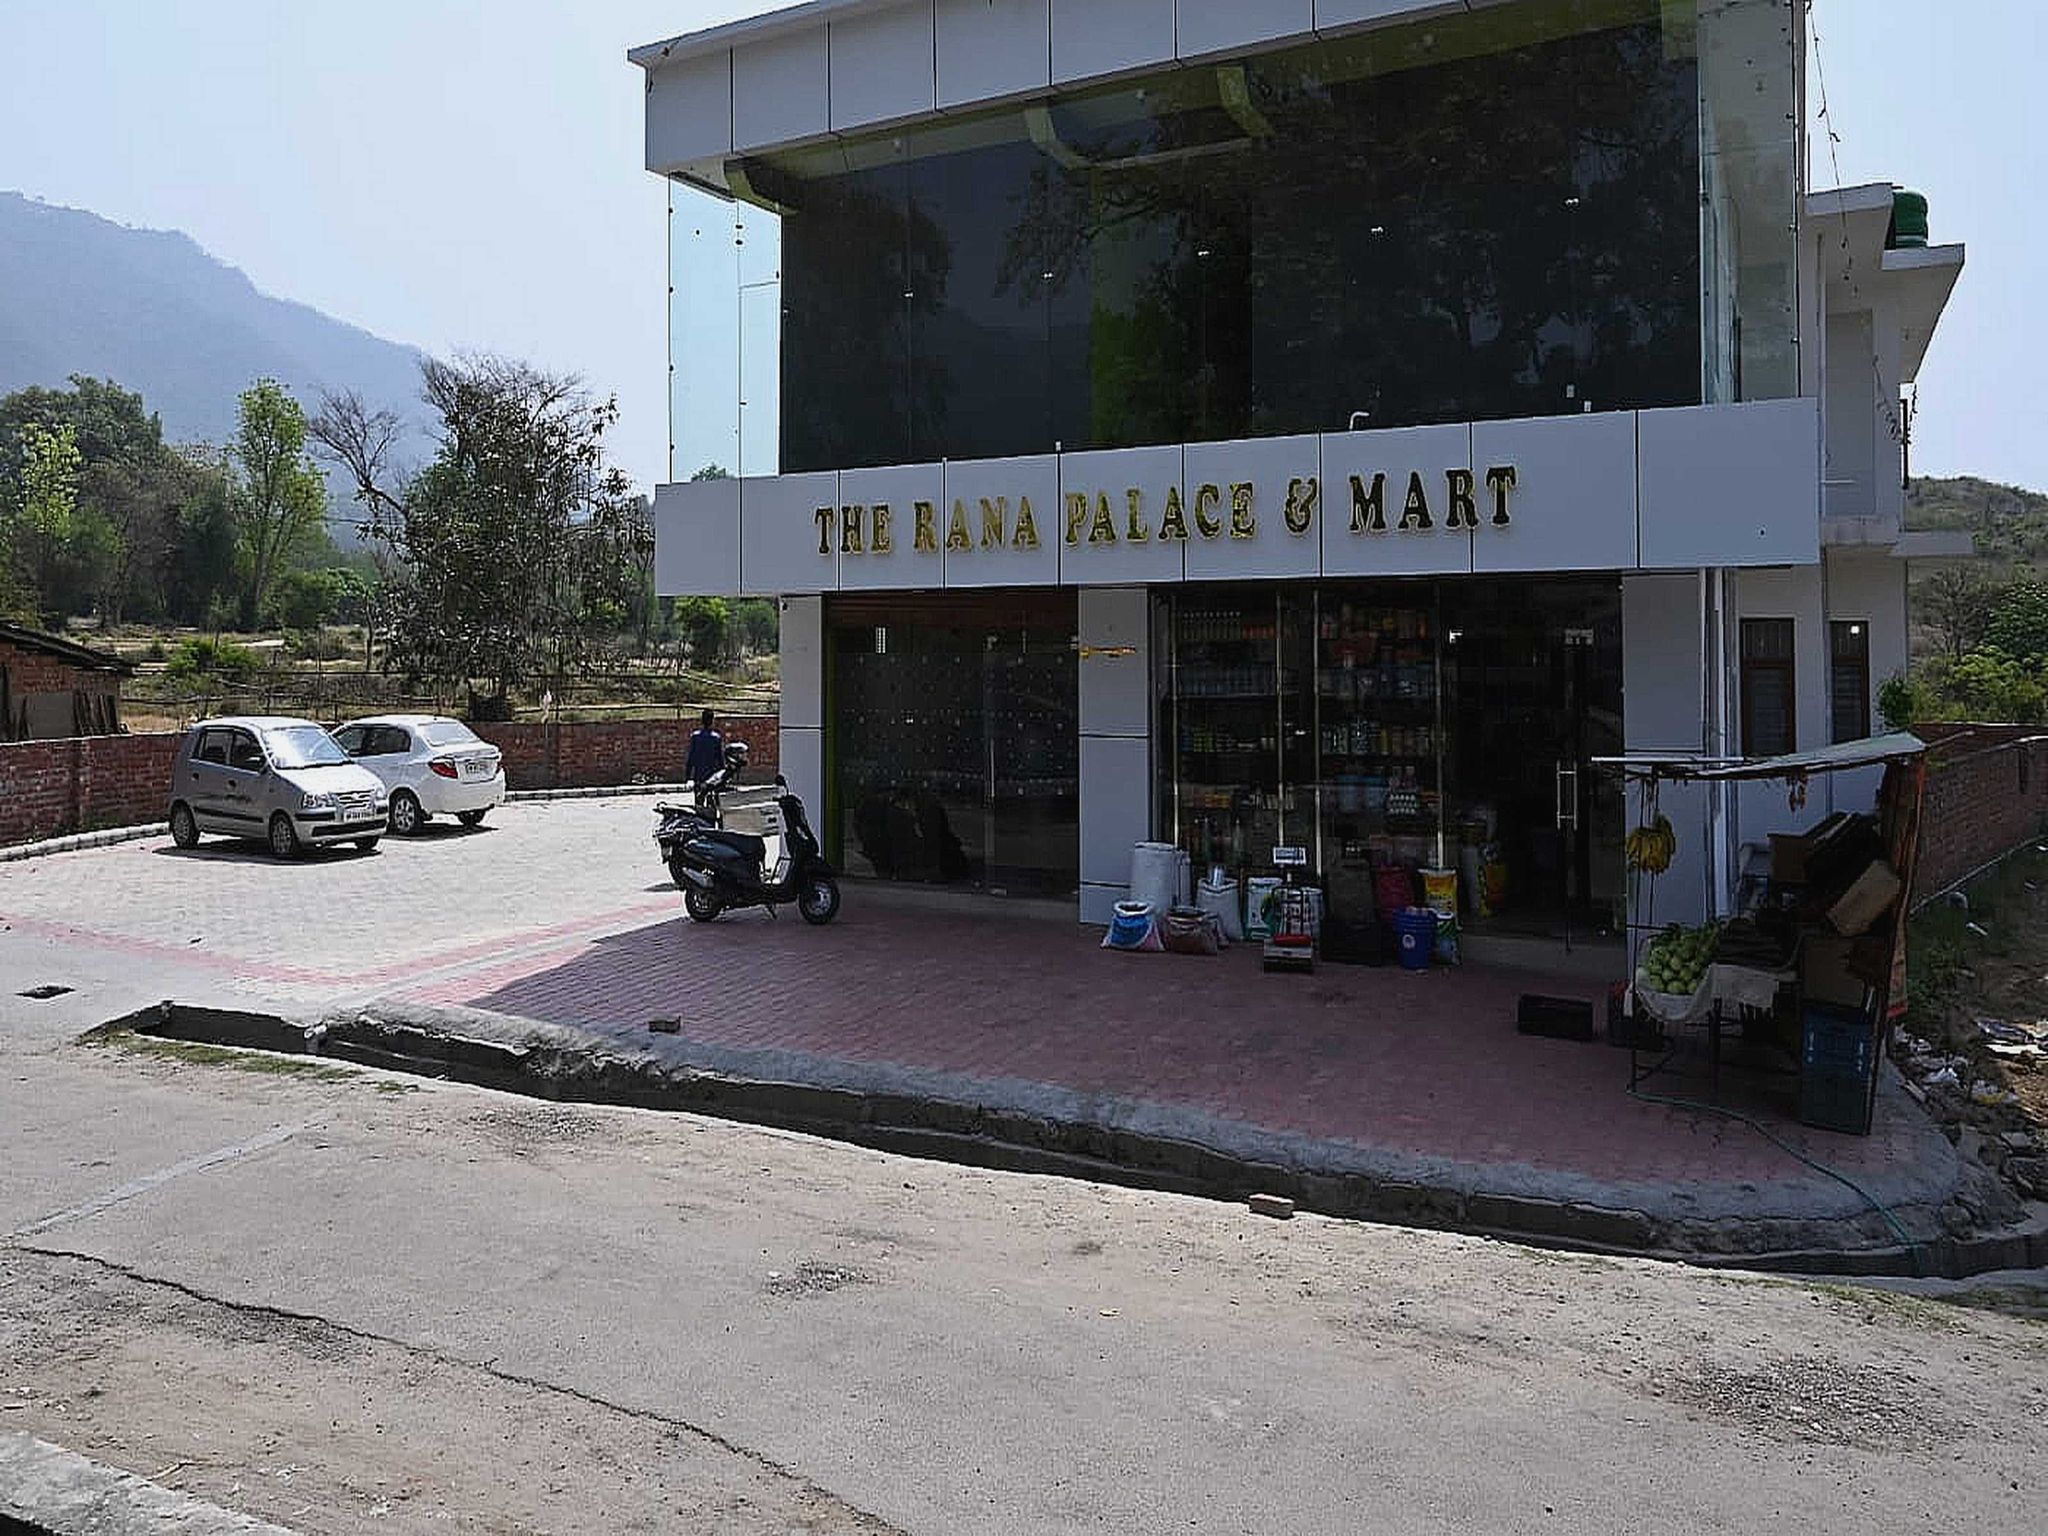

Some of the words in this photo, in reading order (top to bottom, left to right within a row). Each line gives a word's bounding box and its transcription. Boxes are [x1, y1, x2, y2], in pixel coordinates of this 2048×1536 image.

[815, 504, 892, 555] THE
[913, 496, 1041, 552] RANA
[1066, 481, 1256, 543] PALACE
[1285, 477, 1320, 533] &
[1349, 466, 1517, 533] MART
